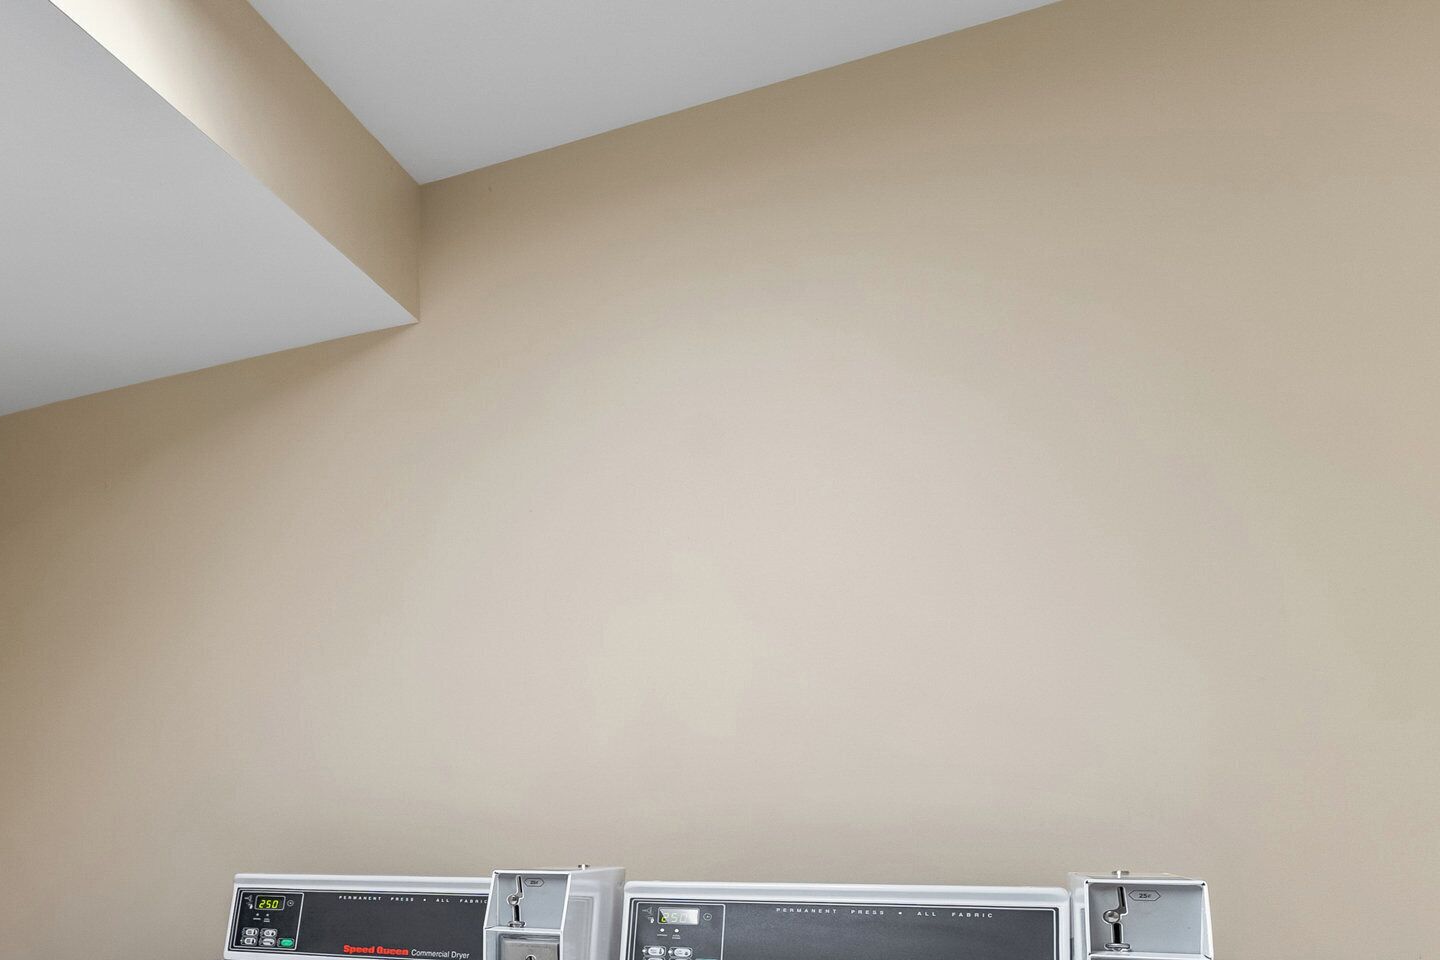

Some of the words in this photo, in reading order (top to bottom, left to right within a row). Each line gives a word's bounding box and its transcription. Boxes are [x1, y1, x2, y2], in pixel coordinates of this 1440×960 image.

[259, 900, 279, 908] 250
[343, 944, 375, 954] Speed
[376, 946, 409, 956] Queen
[411, 948, 450, 958] Commercial
[451, 951, 470, 960] Dryer
